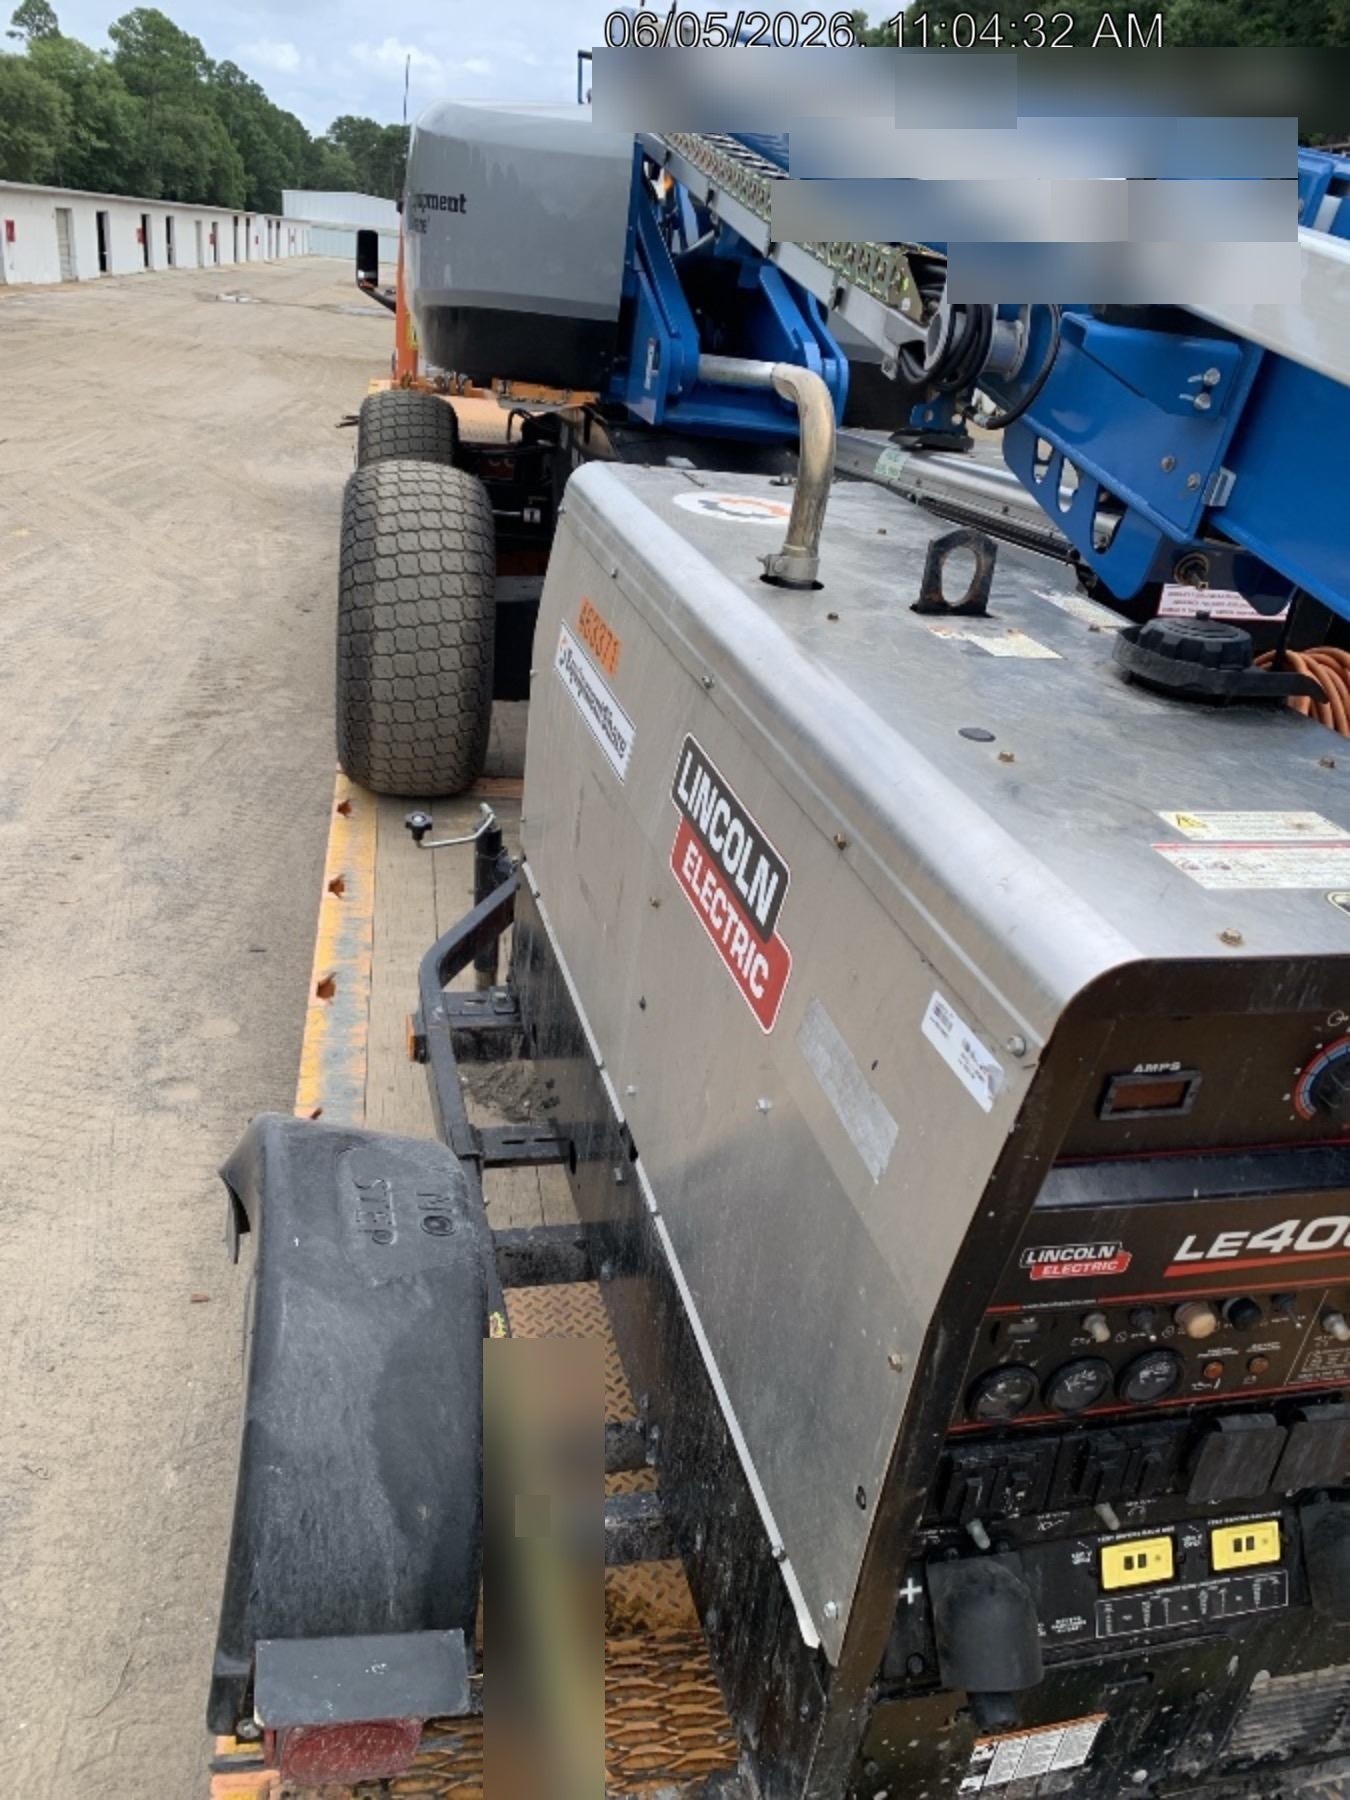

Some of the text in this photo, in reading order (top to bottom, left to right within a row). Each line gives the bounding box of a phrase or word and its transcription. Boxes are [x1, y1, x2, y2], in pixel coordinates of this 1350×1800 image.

[677, 750, 779, 927] LINCOLN
[681, 839, 769, 1000] ELECTRIC
[1133, 1060, 1182, 1074] AMPS
[1174, 1215, 1350, 1261] LE40
[1025, 1245, 1115, 1265] LINCOLN
[1041, 1260, 1119, 1275] ELECTRIC
